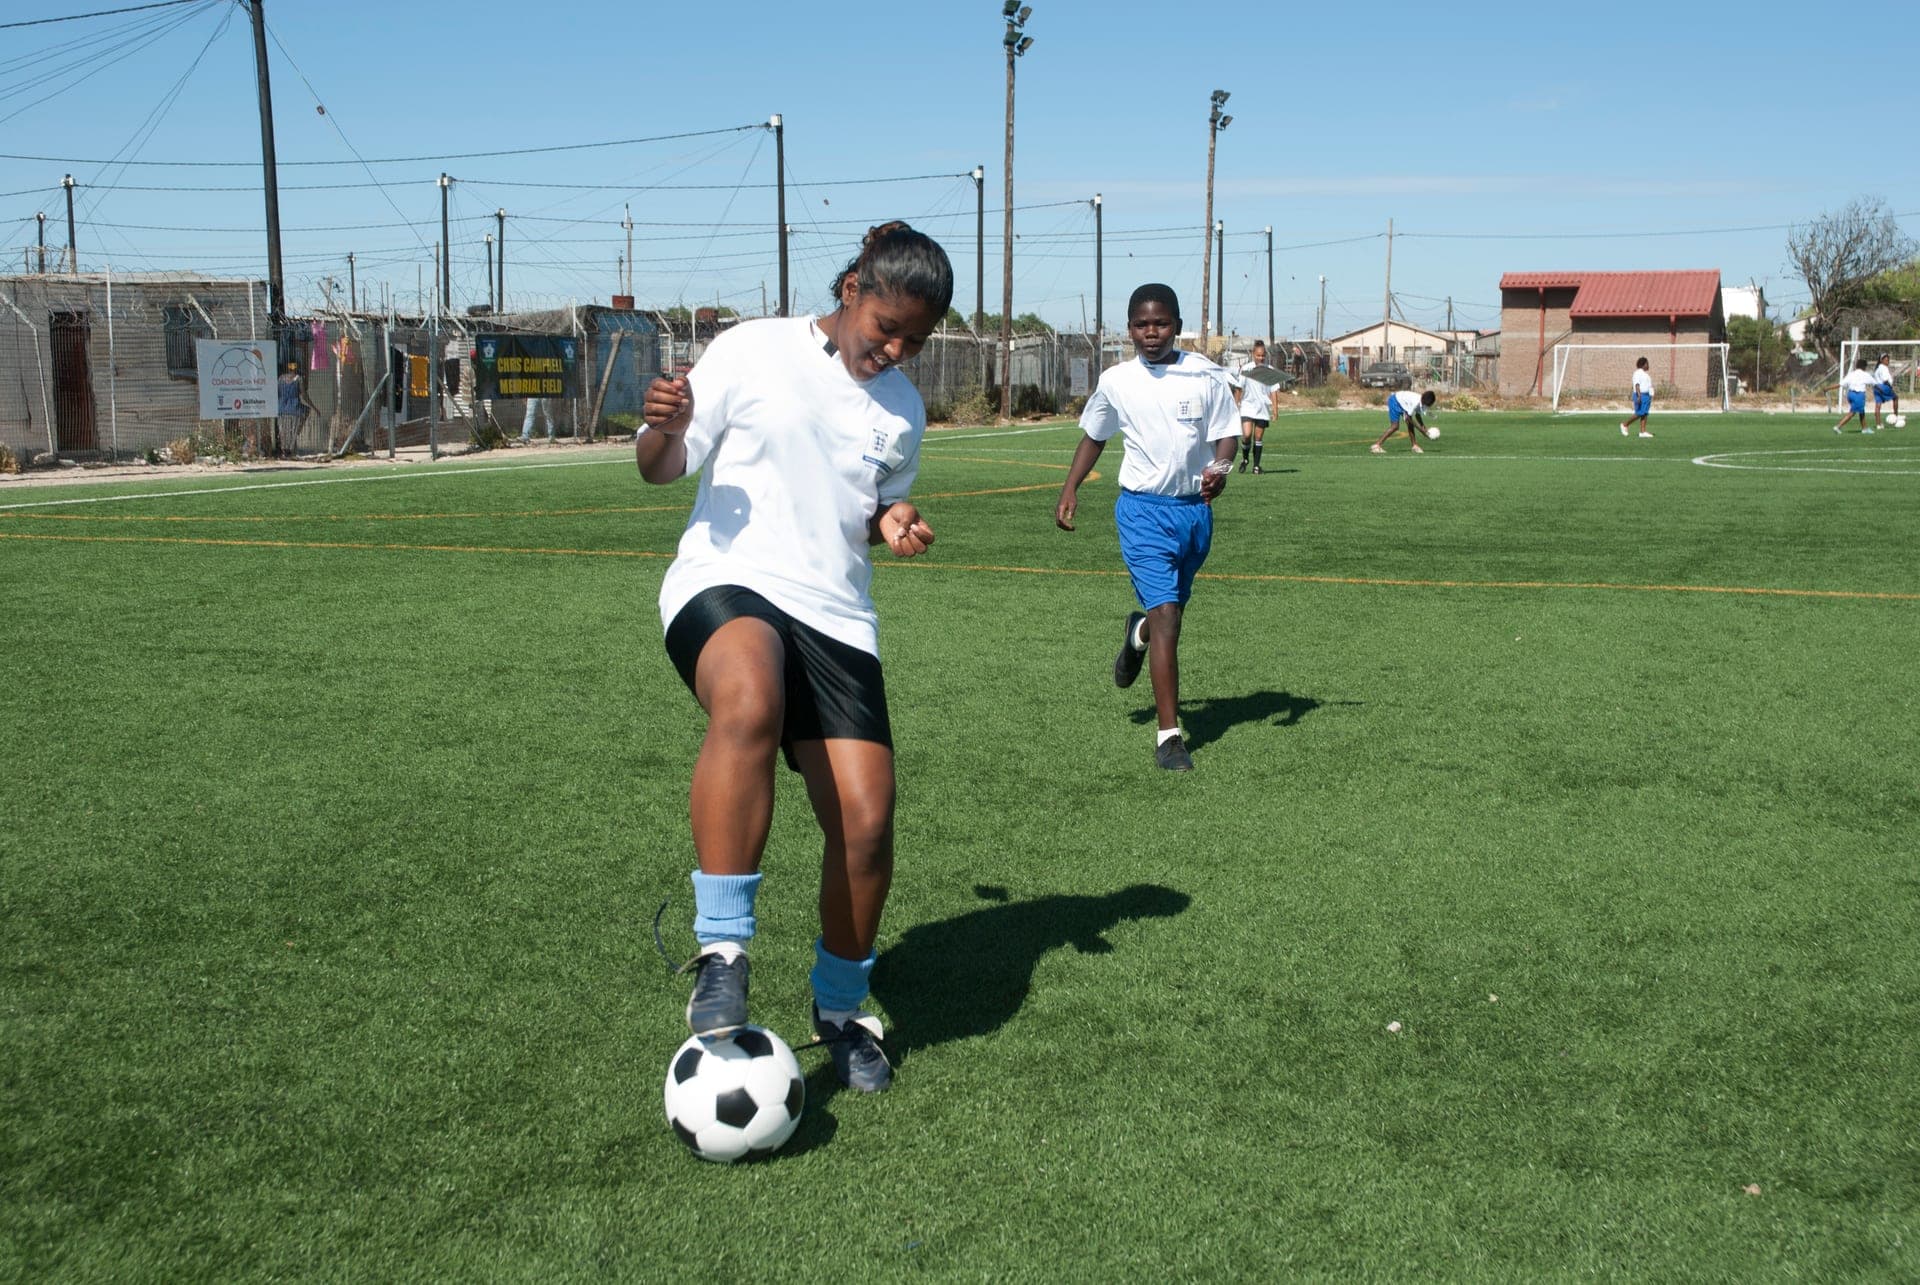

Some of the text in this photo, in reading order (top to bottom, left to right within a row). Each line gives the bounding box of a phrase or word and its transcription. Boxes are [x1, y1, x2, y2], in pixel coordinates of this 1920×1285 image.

[498, 357, 563, 372] CHRIS CAMPBELL
[500, 378, 562, 394] MEMORIAL FIELD
